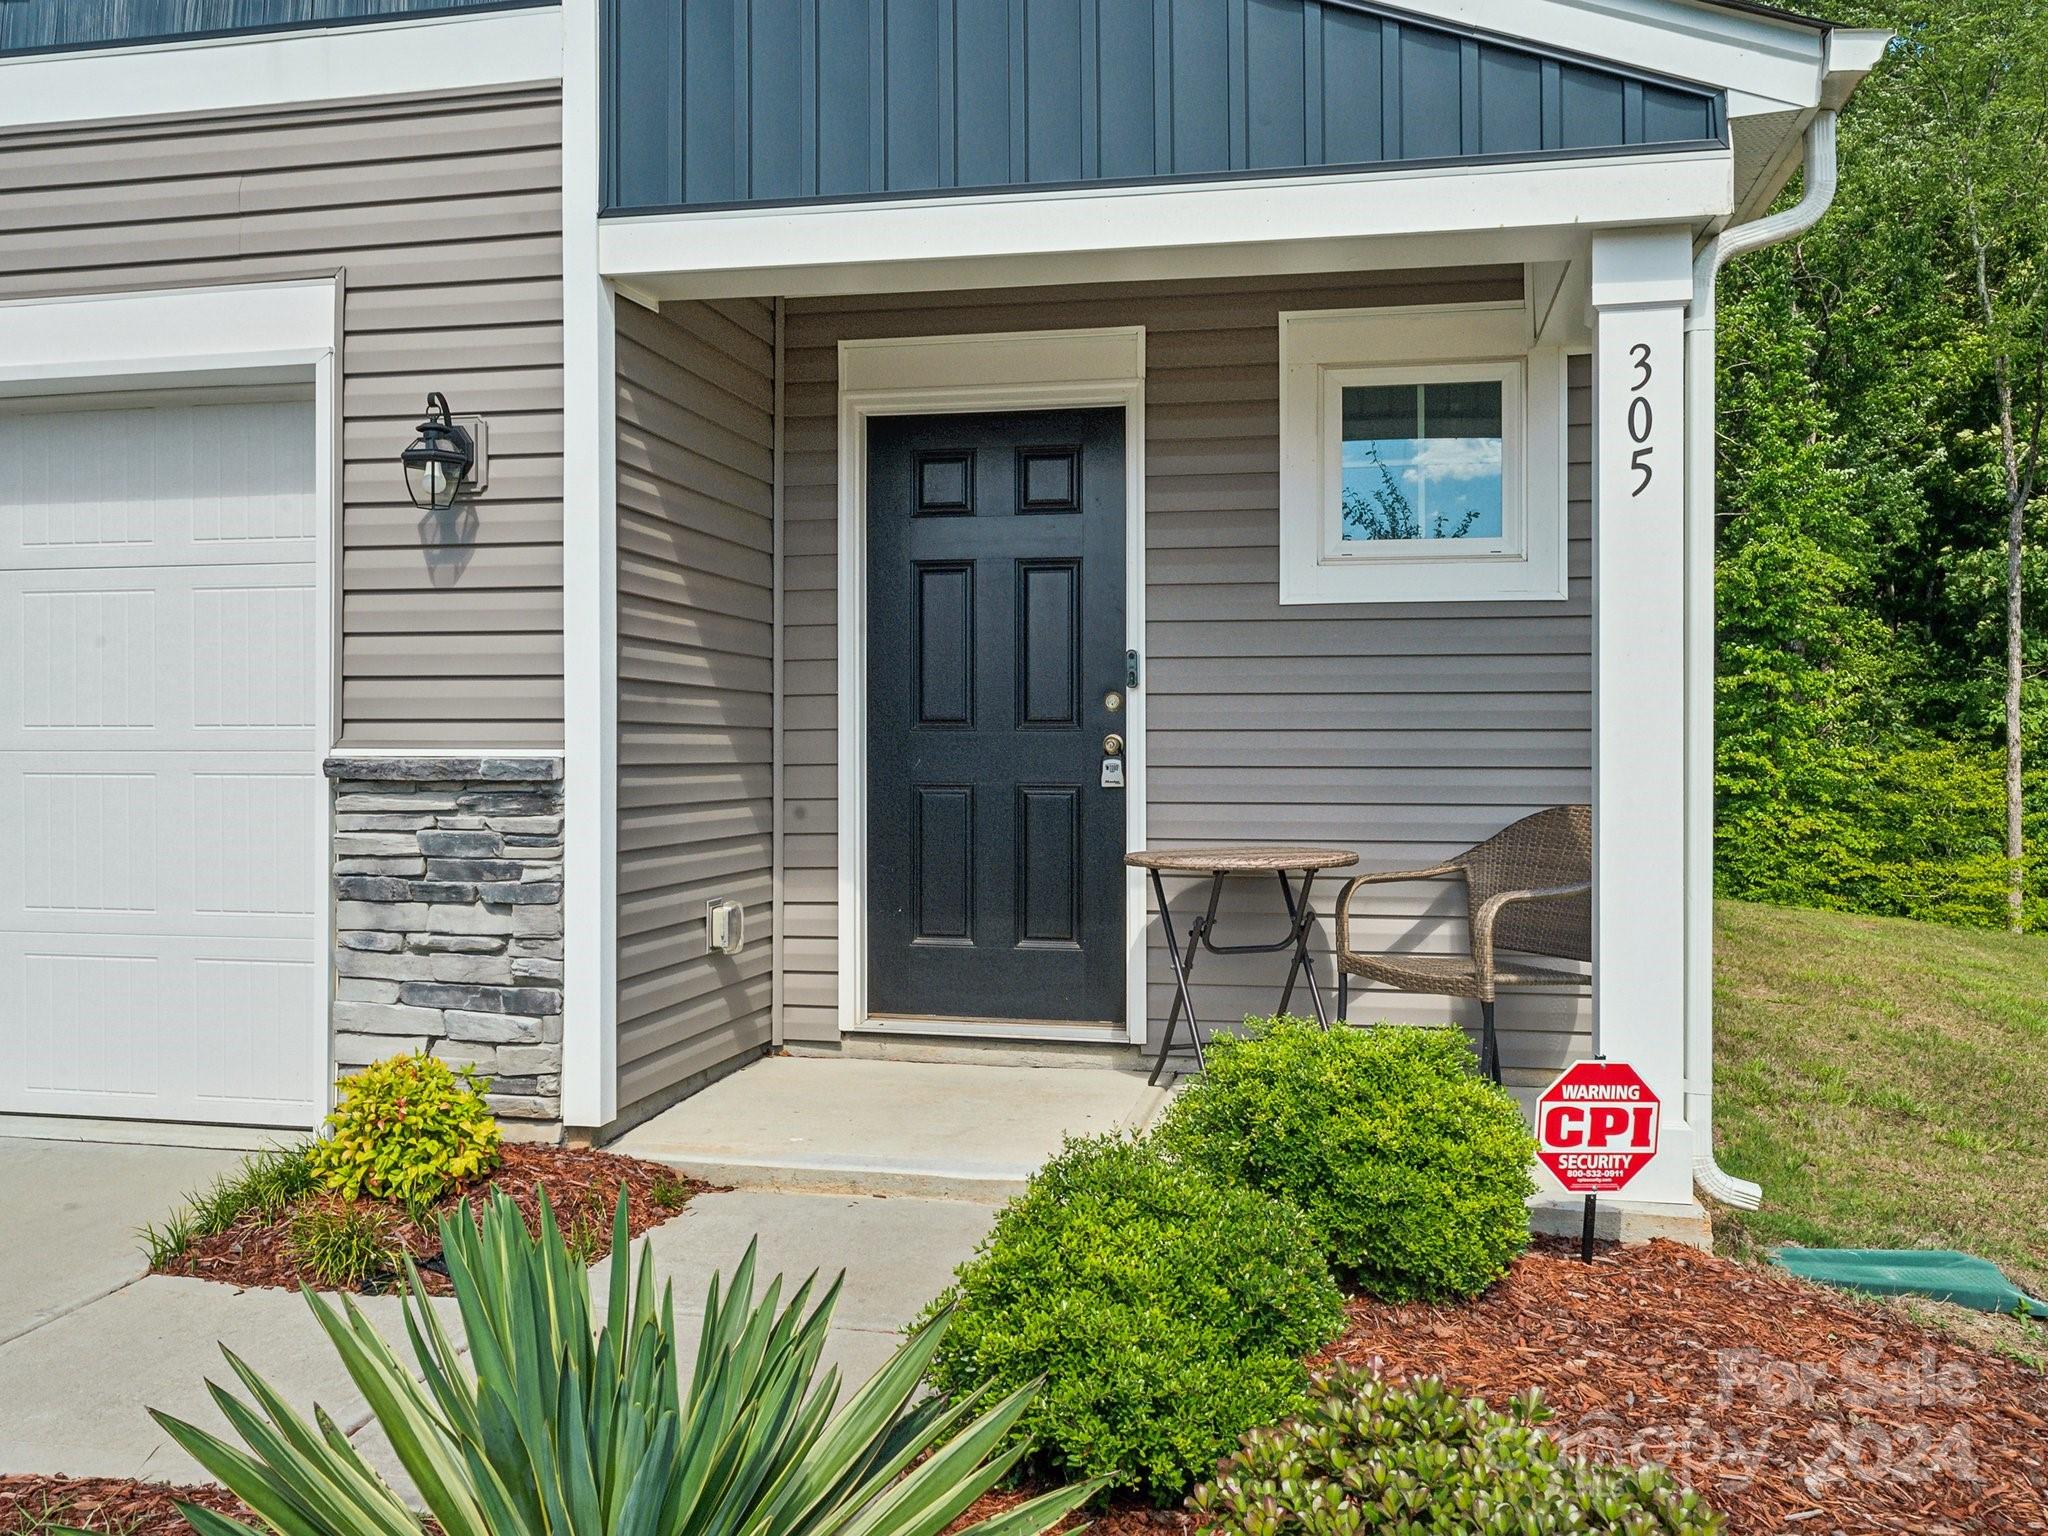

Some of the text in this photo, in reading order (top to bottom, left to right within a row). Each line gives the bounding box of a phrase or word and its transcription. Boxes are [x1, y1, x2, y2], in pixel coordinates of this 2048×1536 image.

[1628, 343, 1653, 498] 305
[1561, 1084, 1640, 1100] WARNING
[1545, 1106, 1653, 1147] CPI
[1558, 1154, 1633, 1169] SECURITY
[1566, 1169, 1624, 1178] 800-532-0911
